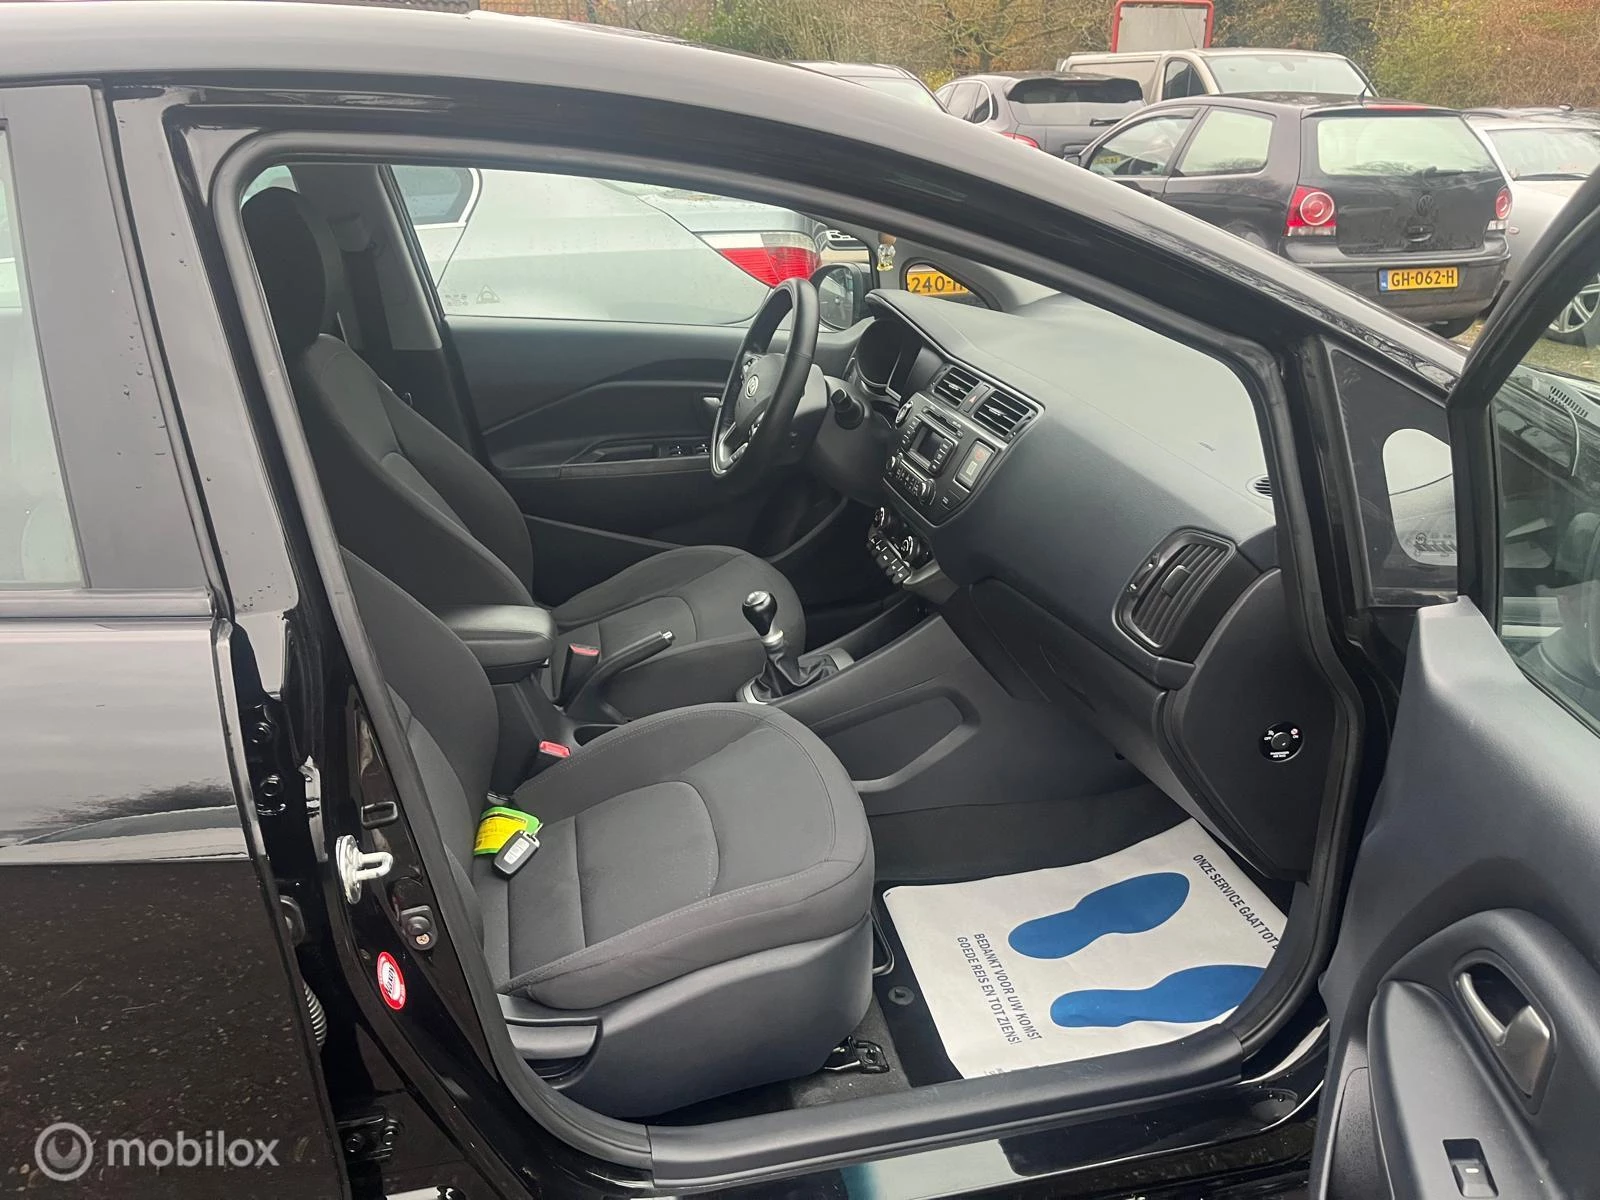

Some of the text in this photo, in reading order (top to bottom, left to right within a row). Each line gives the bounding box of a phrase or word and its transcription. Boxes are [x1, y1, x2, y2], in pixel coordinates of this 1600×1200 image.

[1391, 270, 1455, 287] GH-062-H
[1193, 854, 1280, 943] ONZE SERVICE GAAT TOT
[957, 936, 1022, 1045] GOEDE REIS EN TOT ZIENS!
[974, 933, 1043, 1040] BEDANKT VOOR UW KOMST
